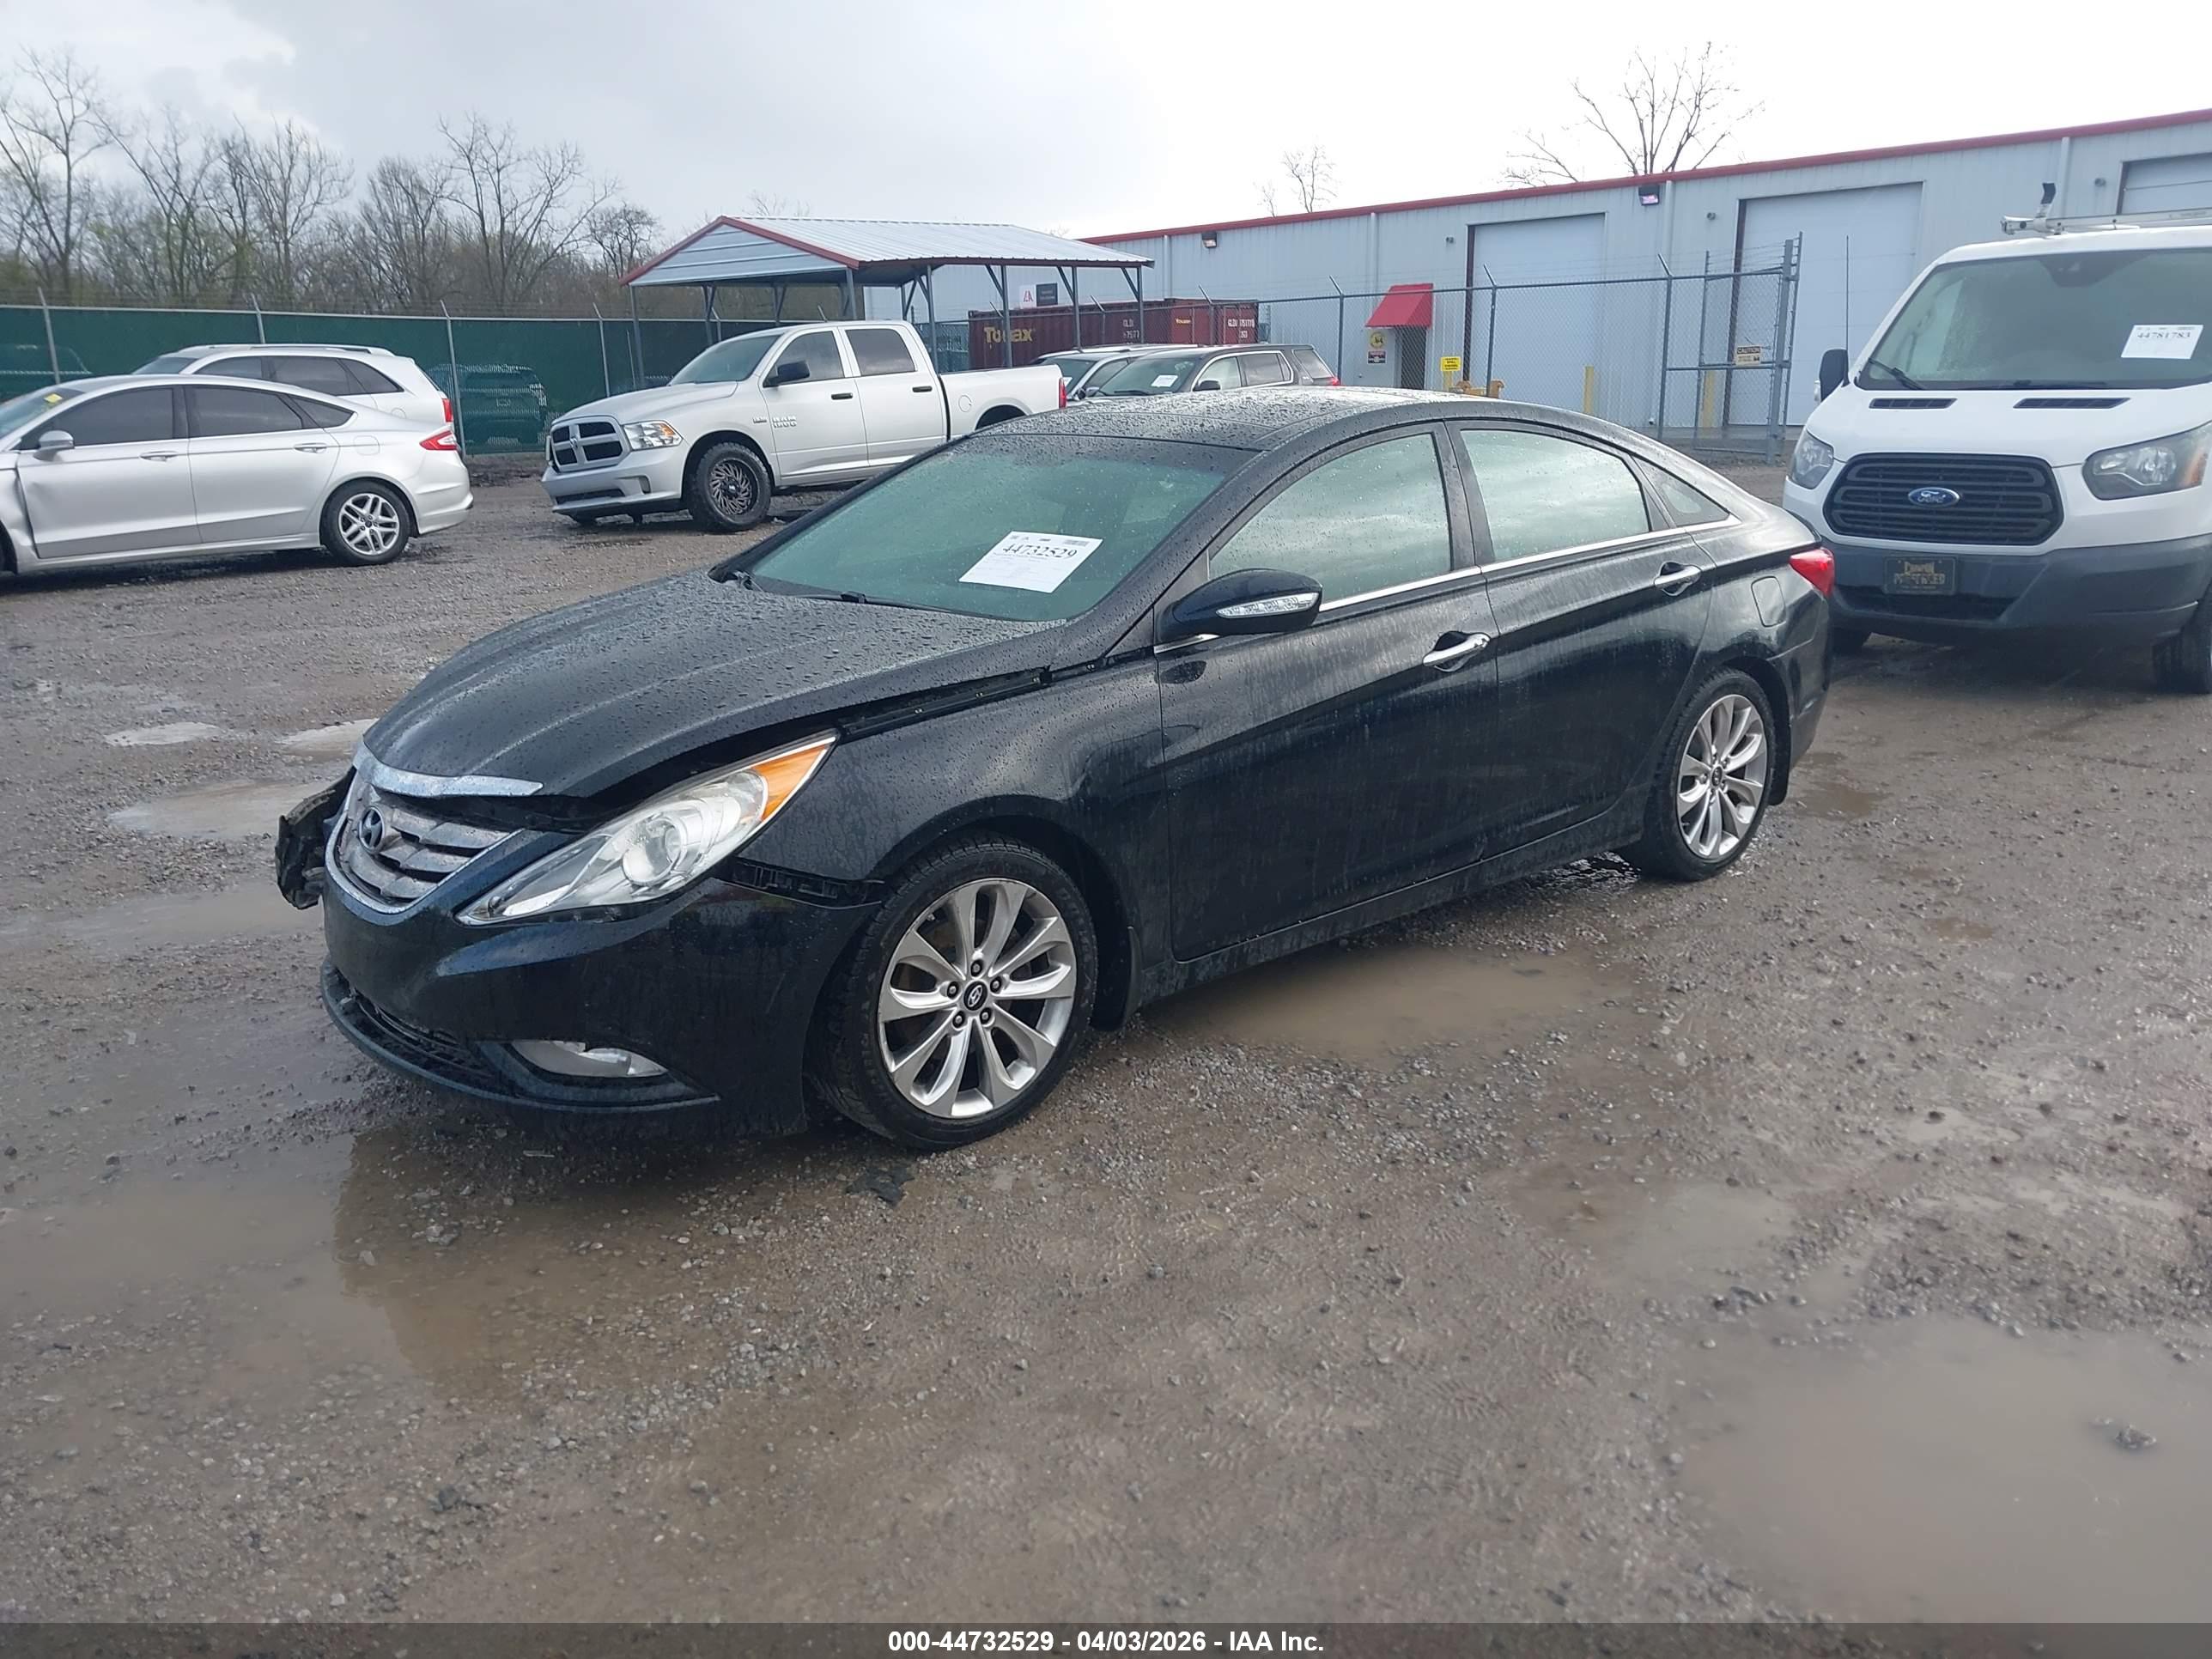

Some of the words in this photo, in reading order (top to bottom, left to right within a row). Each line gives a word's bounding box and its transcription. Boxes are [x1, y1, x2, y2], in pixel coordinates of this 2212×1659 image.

[2137, 331, 2191, 339] 44781783
[1917, 490, 1947, 503] Ford
[1002, 543, 1078, 559] 44732529
